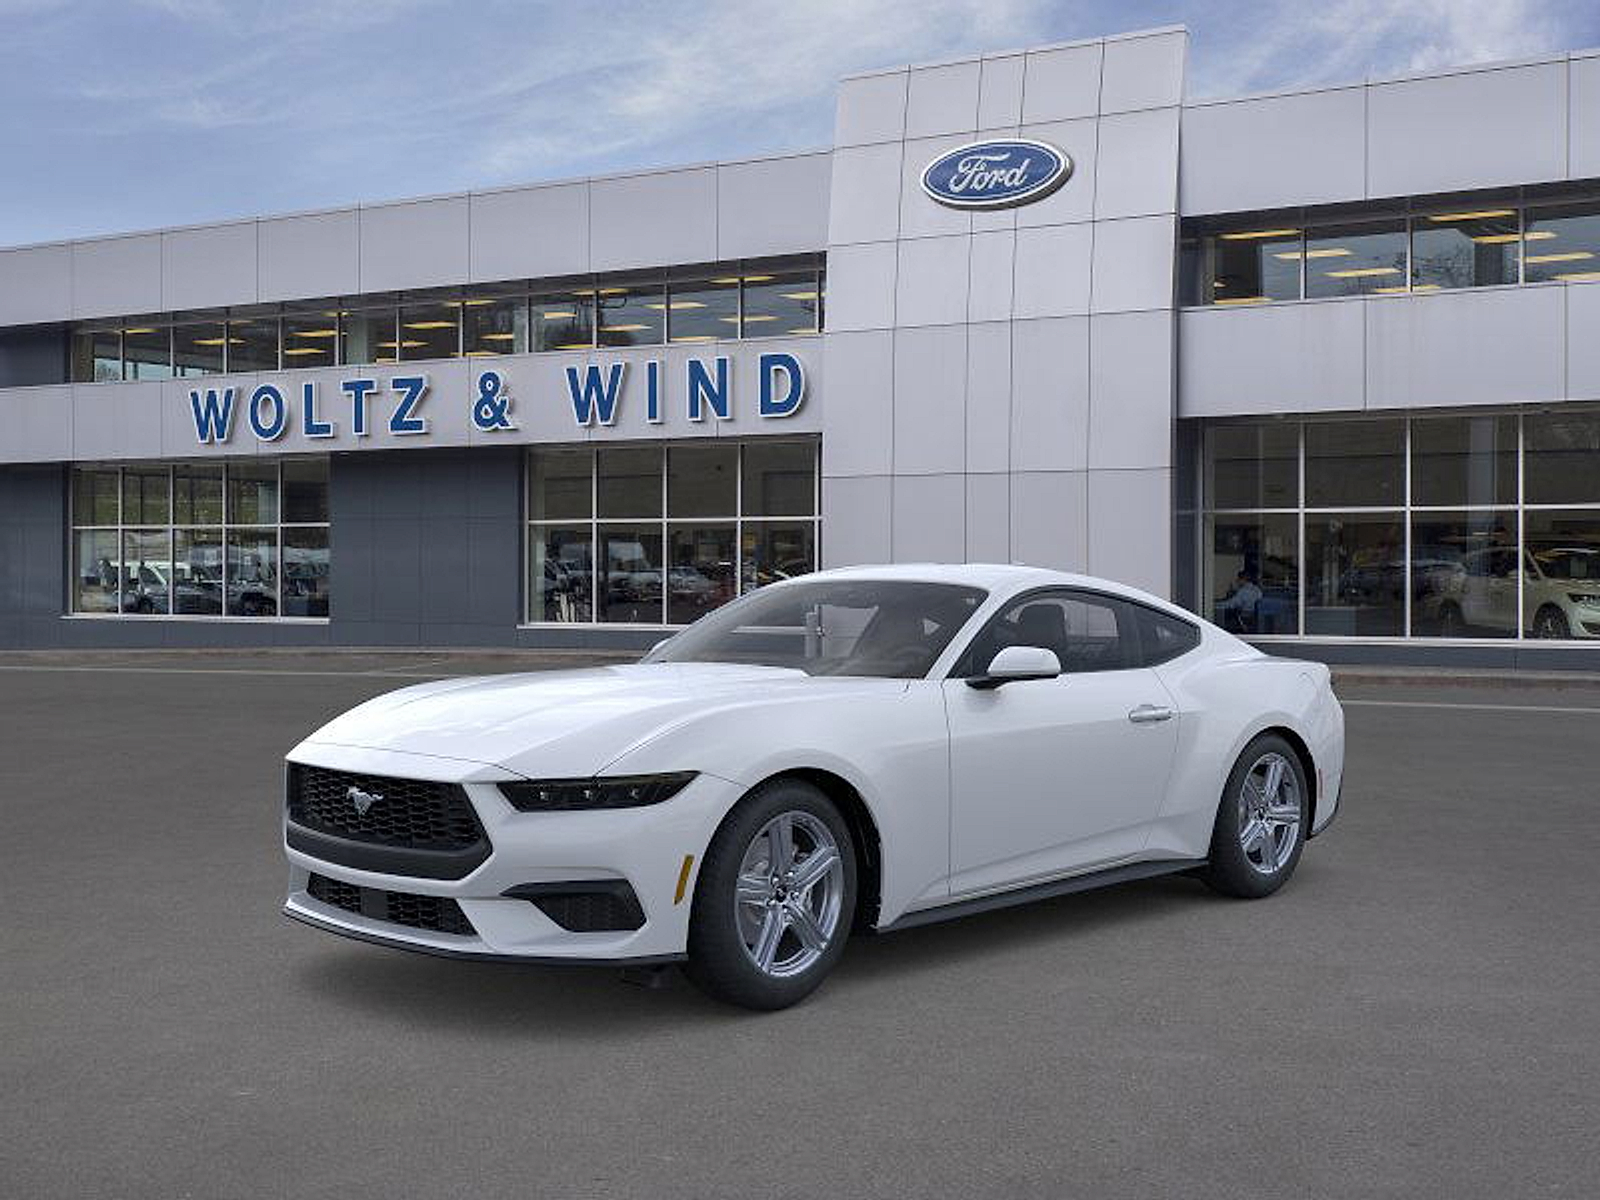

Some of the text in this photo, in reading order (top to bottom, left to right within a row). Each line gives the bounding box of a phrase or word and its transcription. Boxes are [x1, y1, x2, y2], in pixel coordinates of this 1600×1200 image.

[950, 152, 1031, 193] Ford
[190, 353, 806, 443] WOLTZ & WIND
